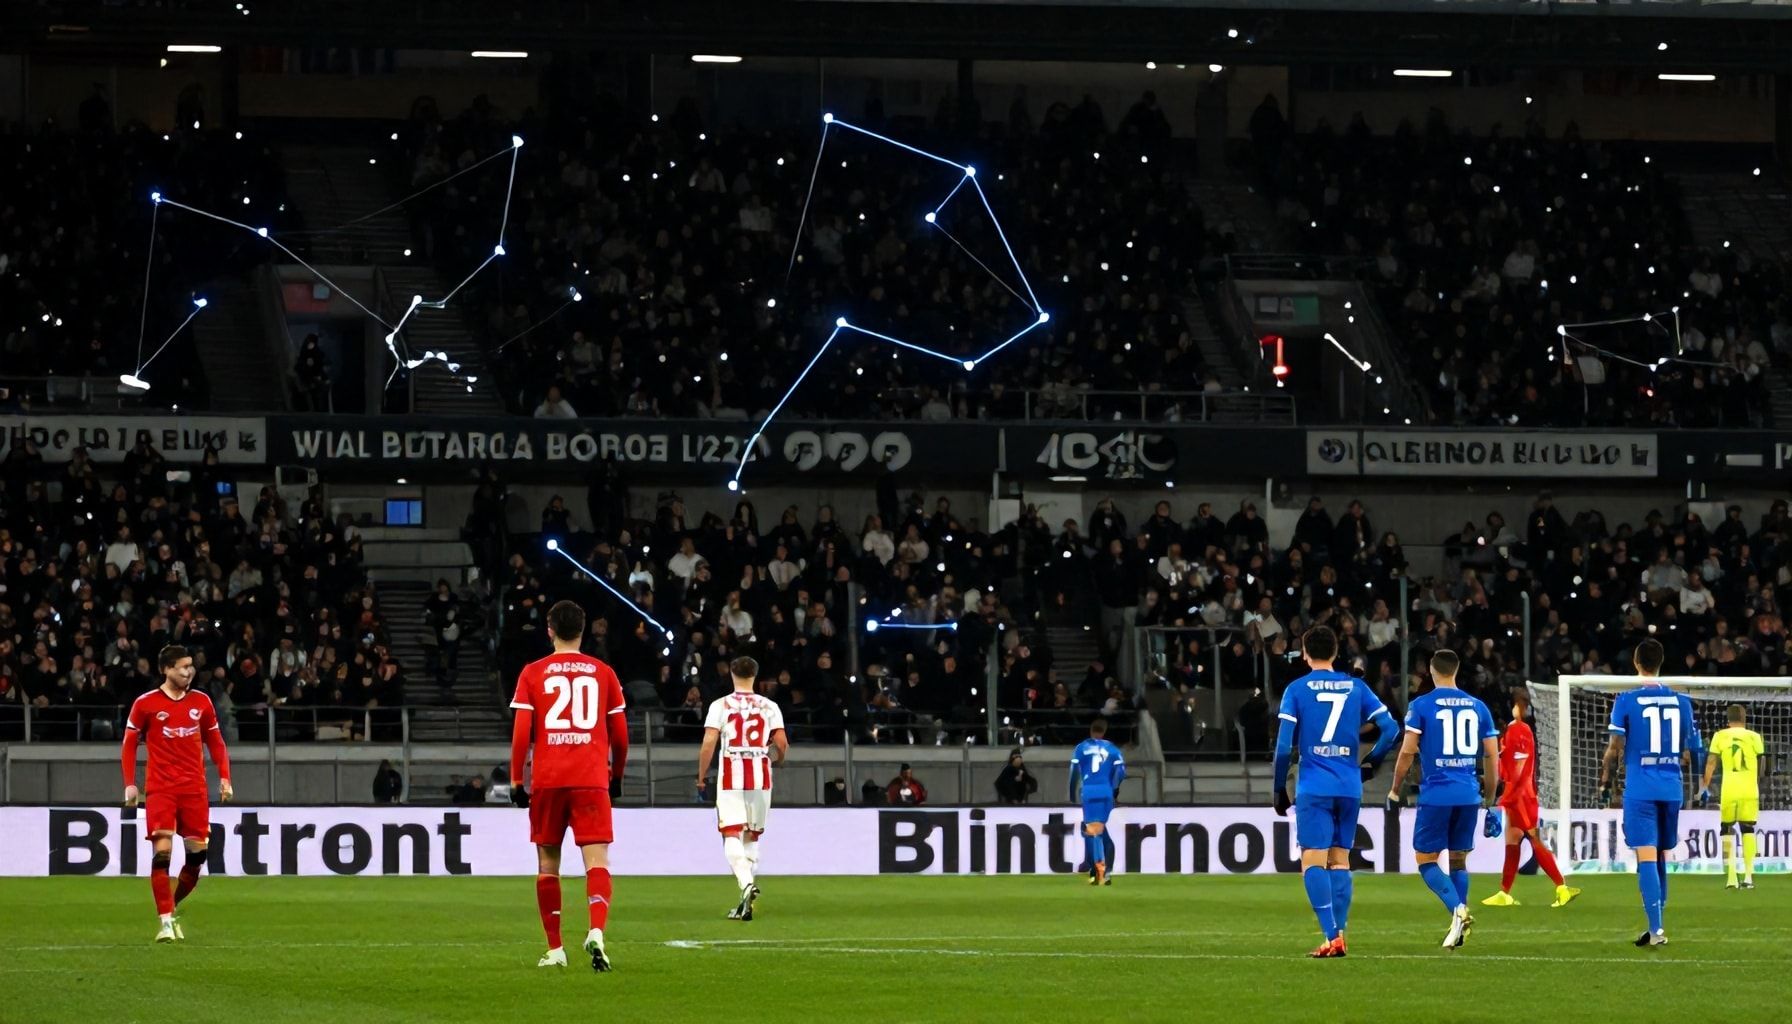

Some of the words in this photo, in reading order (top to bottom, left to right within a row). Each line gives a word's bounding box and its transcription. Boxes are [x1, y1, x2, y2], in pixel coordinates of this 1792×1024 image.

[544, 676, 598, 729] 20
[1316, 692, 1348, 742] 7
[1436, 709, 1478, 755] 10
[1643, 707, 1680, 754] 11
